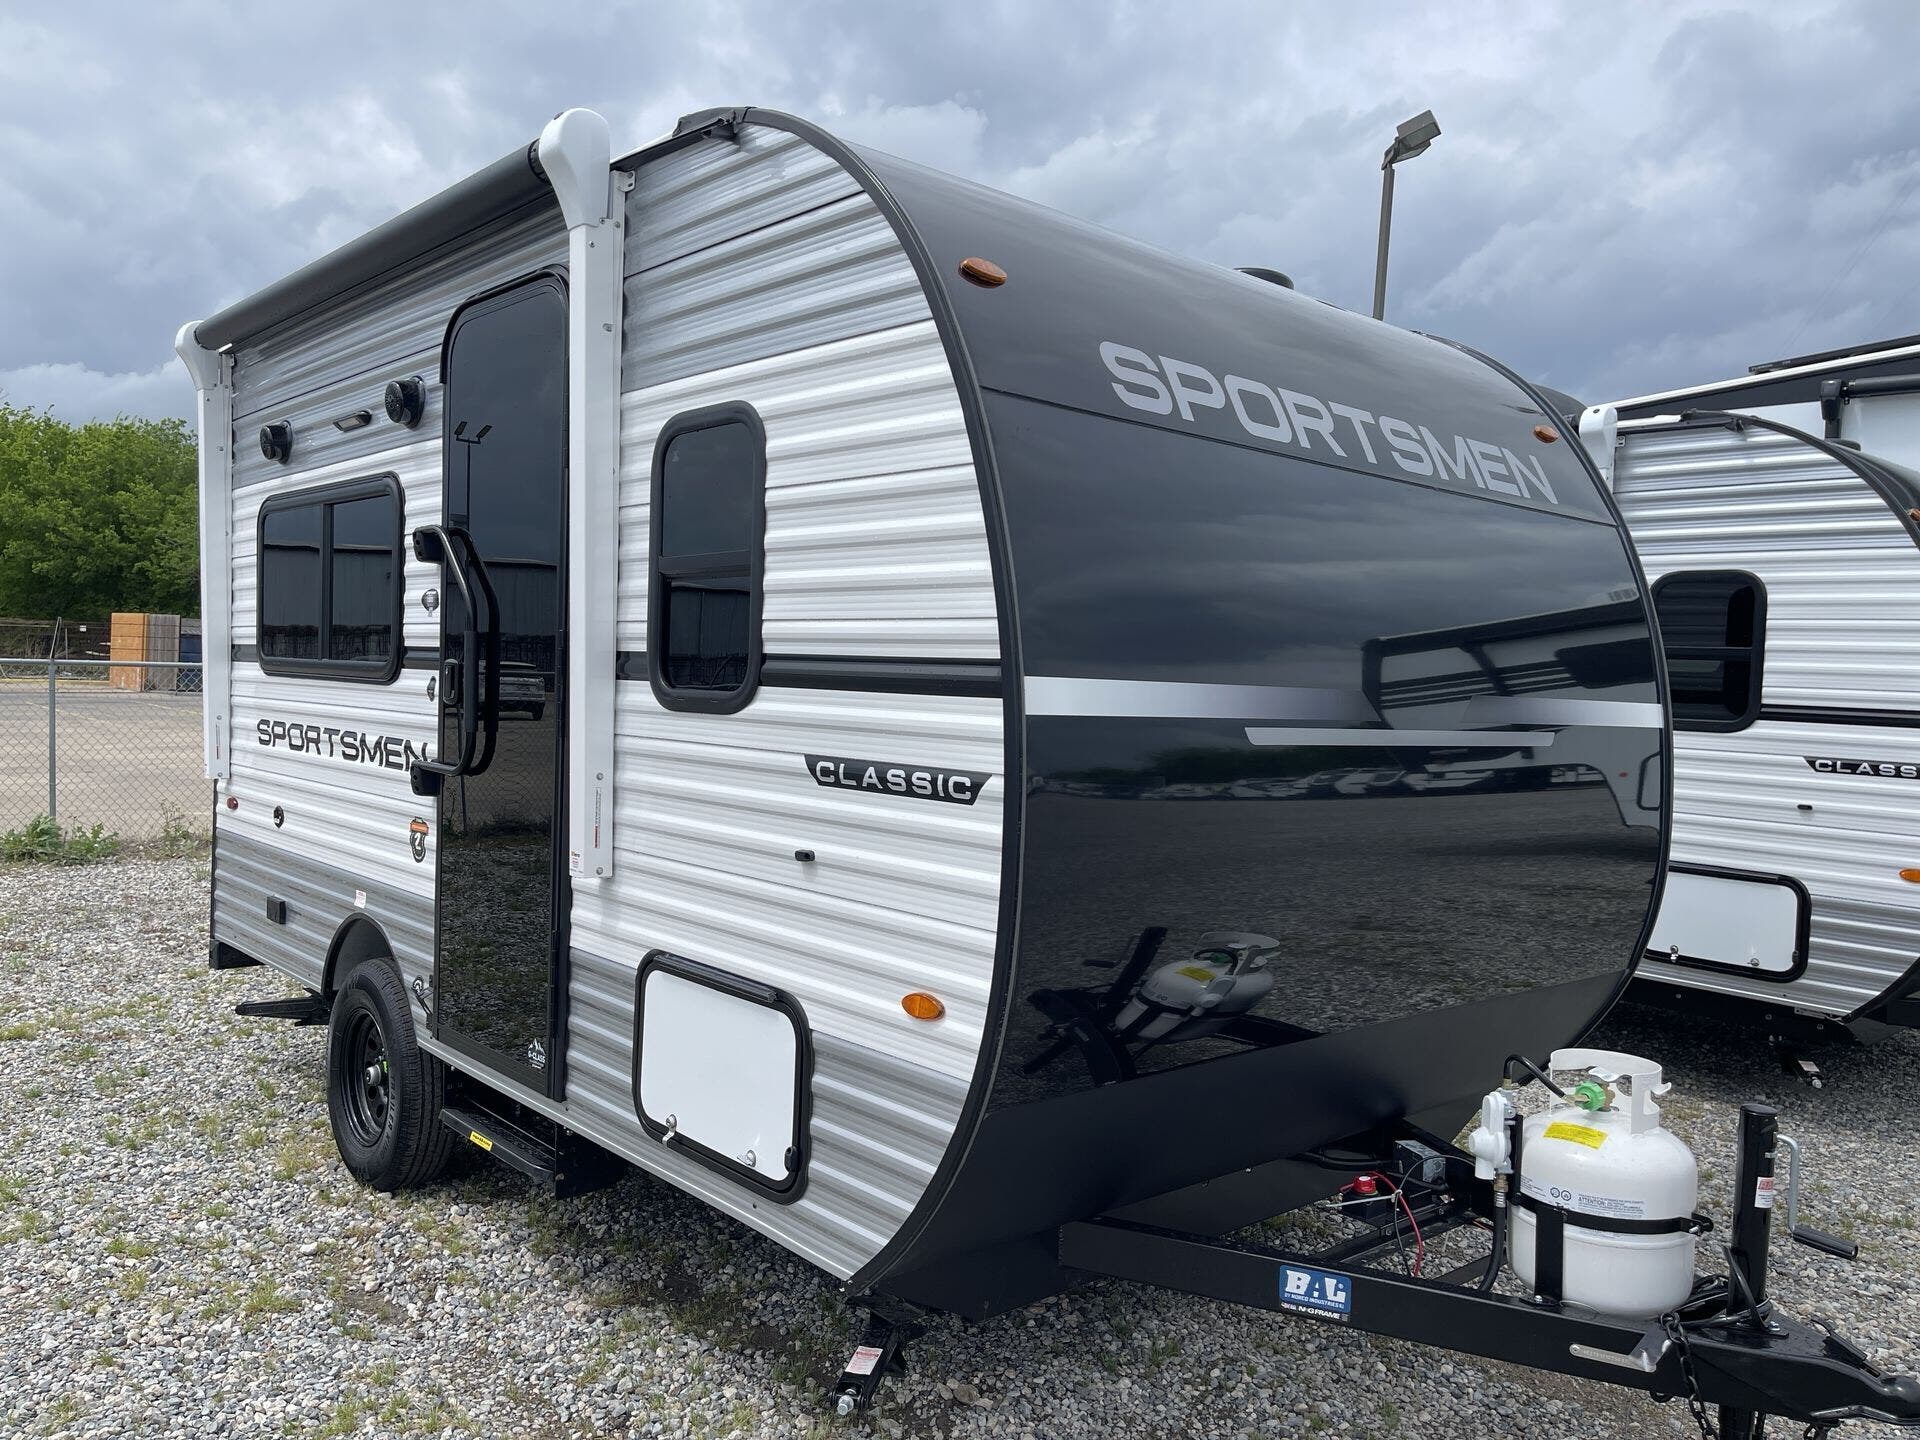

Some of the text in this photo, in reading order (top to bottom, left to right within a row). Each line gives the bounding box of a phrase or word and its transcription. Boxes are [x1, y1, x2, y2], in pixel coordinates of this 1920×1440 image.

[1100, 341, 1558, 504] SPORTSMEN
[256, 718, 428, 772] SPORTSMEN
[815, 760, 972, 800] CLASSIC
[1285, 1270, 1346, 1303] BAL
